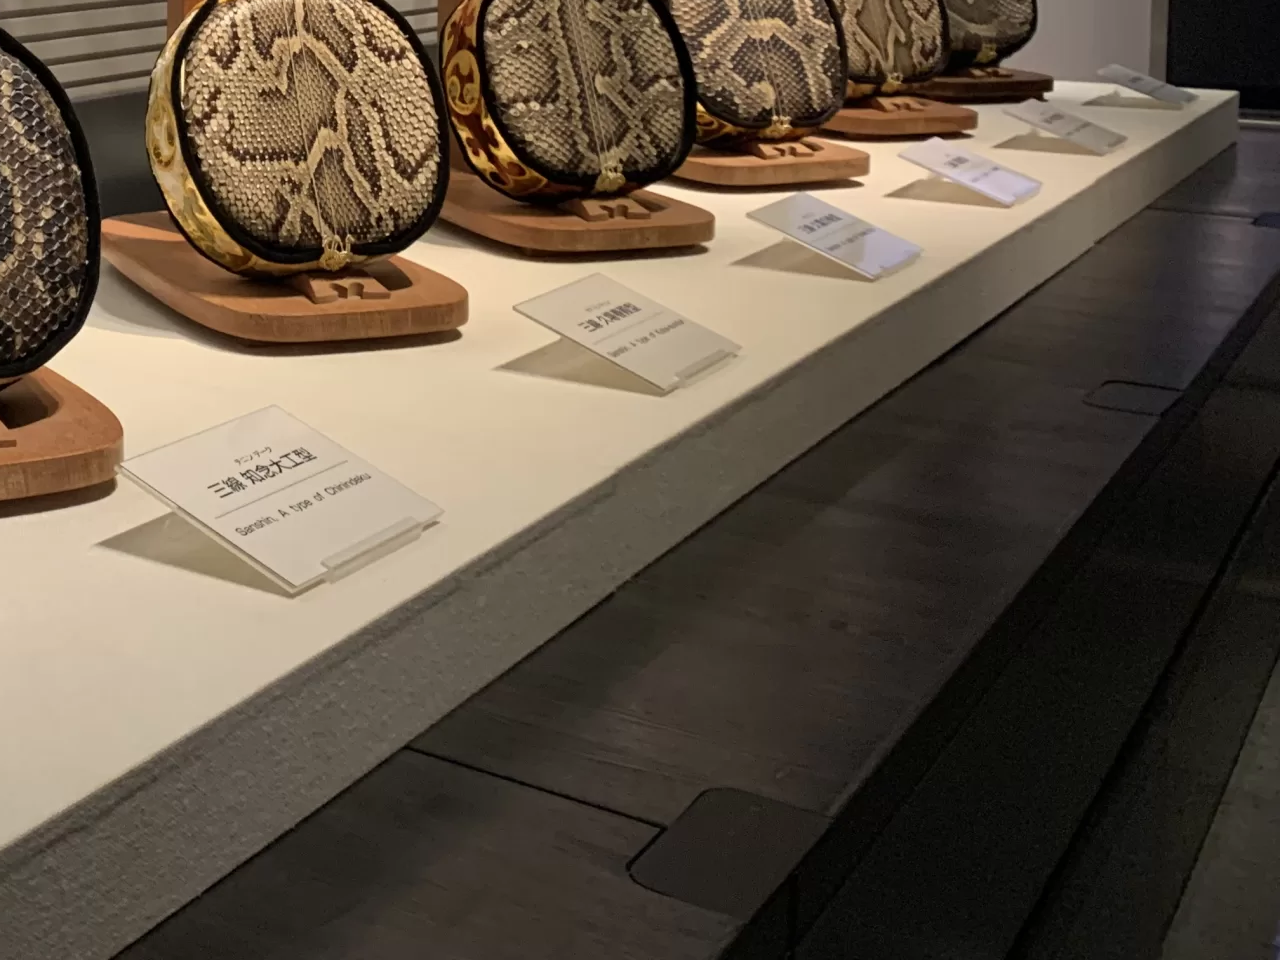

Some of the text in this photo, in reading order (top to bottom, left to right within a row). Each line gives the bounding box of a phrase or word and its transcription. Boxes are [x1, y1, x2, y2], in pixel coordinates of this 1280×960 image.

[207, 447, 317, 499] 三線 知念大工型
[278, 509, 290, 517] A
[289, 499, 313, 512] type
[313, 492, 325, 501] of
